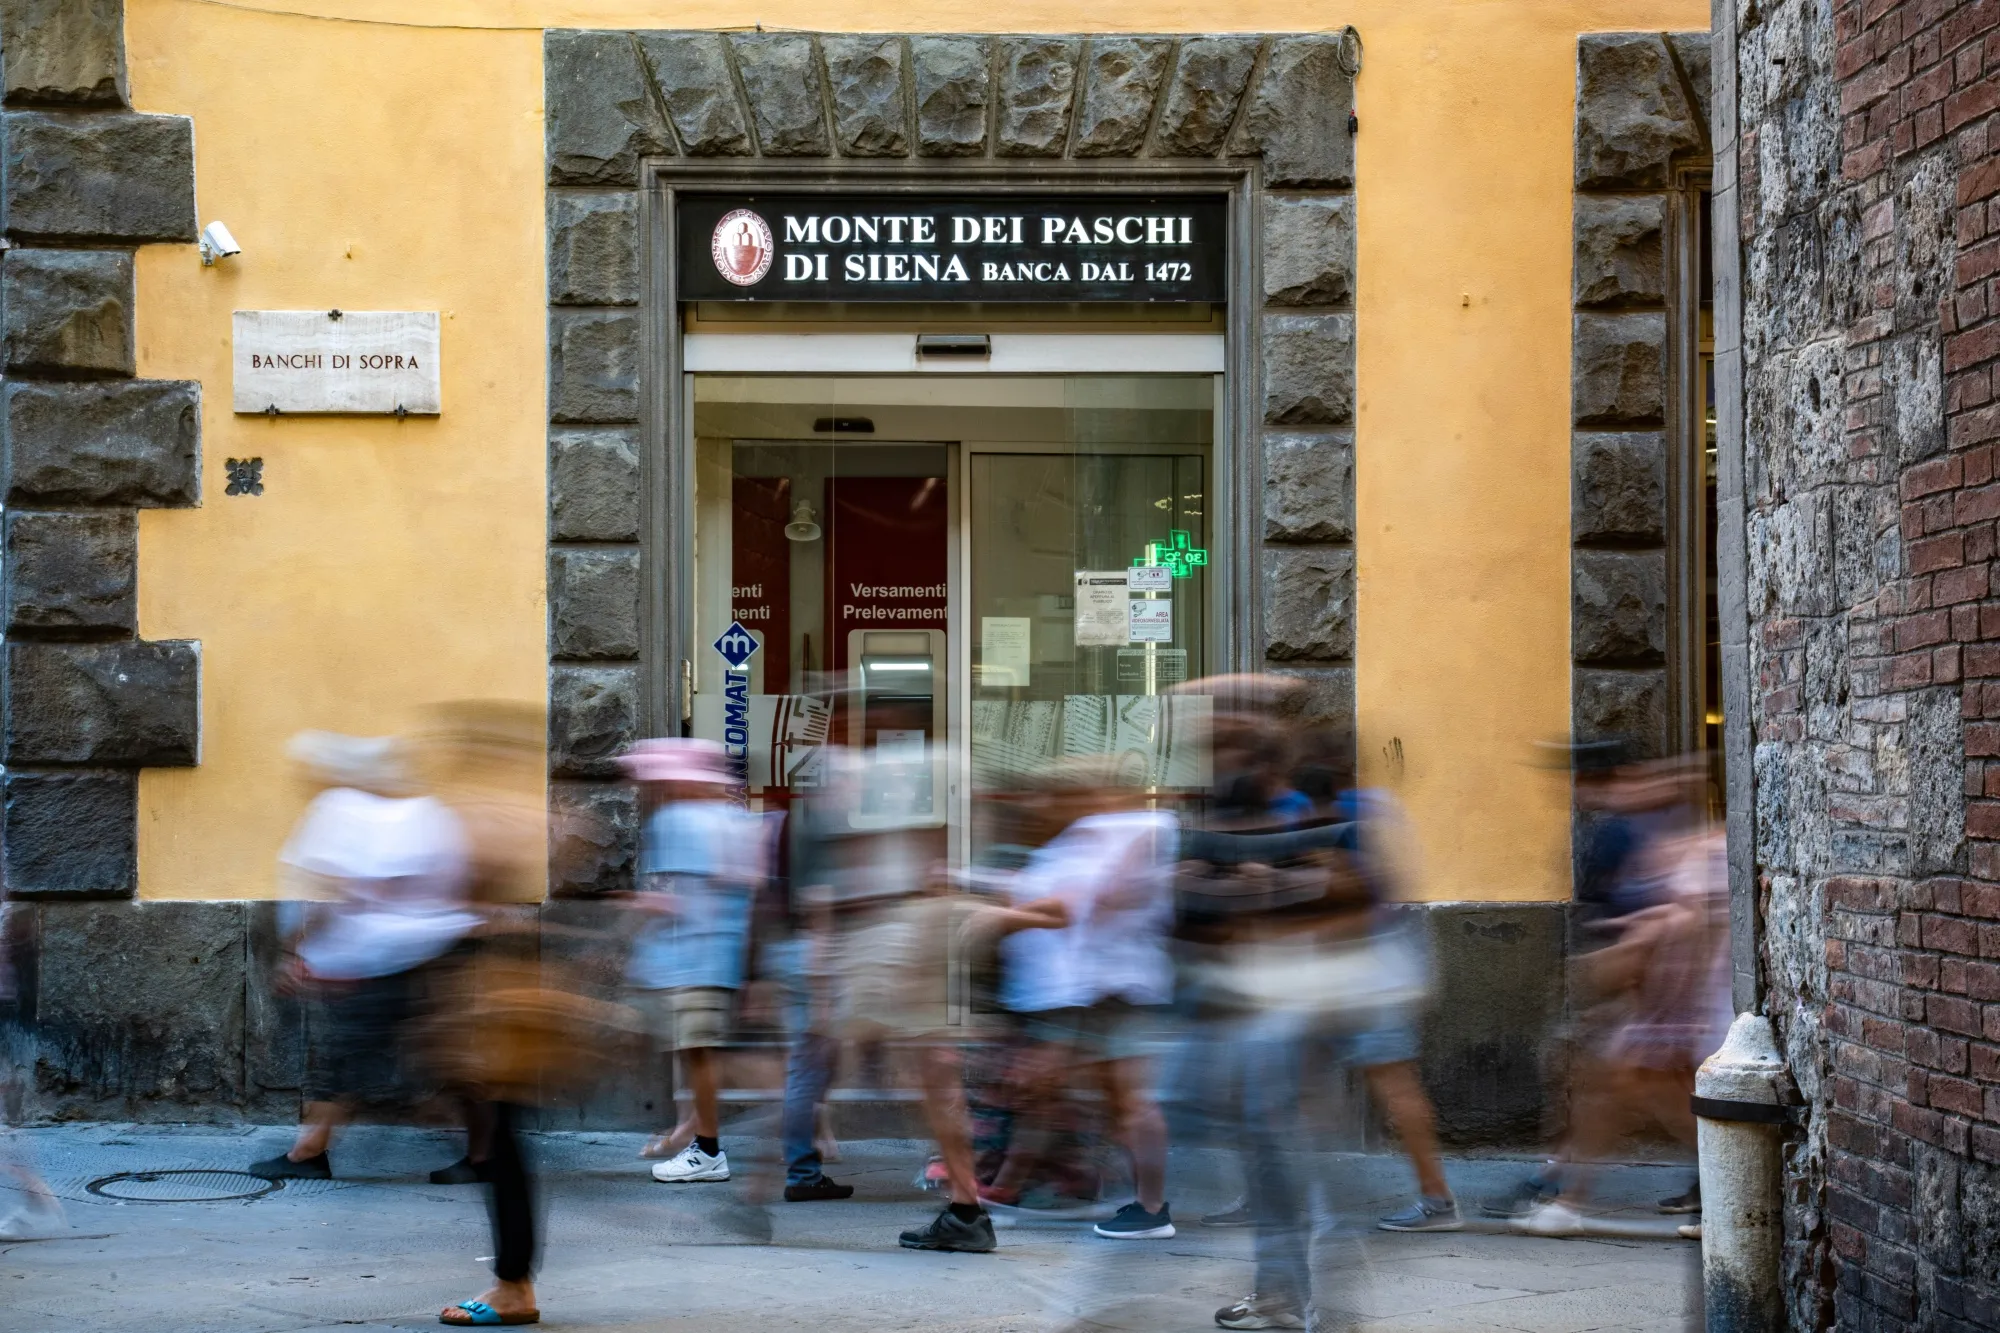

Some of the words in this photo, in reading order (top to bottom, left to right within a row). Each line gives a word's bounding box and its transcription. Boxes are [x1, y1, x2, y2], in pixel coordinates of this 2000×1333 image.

[784, 216, 936, 243] MONTE
[951, 216, 1024, 243] DEI
[1041, 216, 1193, 244] PASCHI
[784, 254, 829, 281] DI
[845, 254, 970, 281] SIENA
[982, 263, 1071, 281] BANCA
[1081, 263, 1134, 281] DAL
[1145, 263, 1192, 281] 1472
[252, 354, 322, 369] BANCHI
[332, 355, 350, 369] DI
[360, 354, 419, 369] SOPRA
[732, 584, 763, 598] enti
[850, 583, 947, 598] Versamenti
[732, 604, 770, 619] enti
[843, 604, 947, 619] Prelevament
[687, 1157, 701, 1168] N
